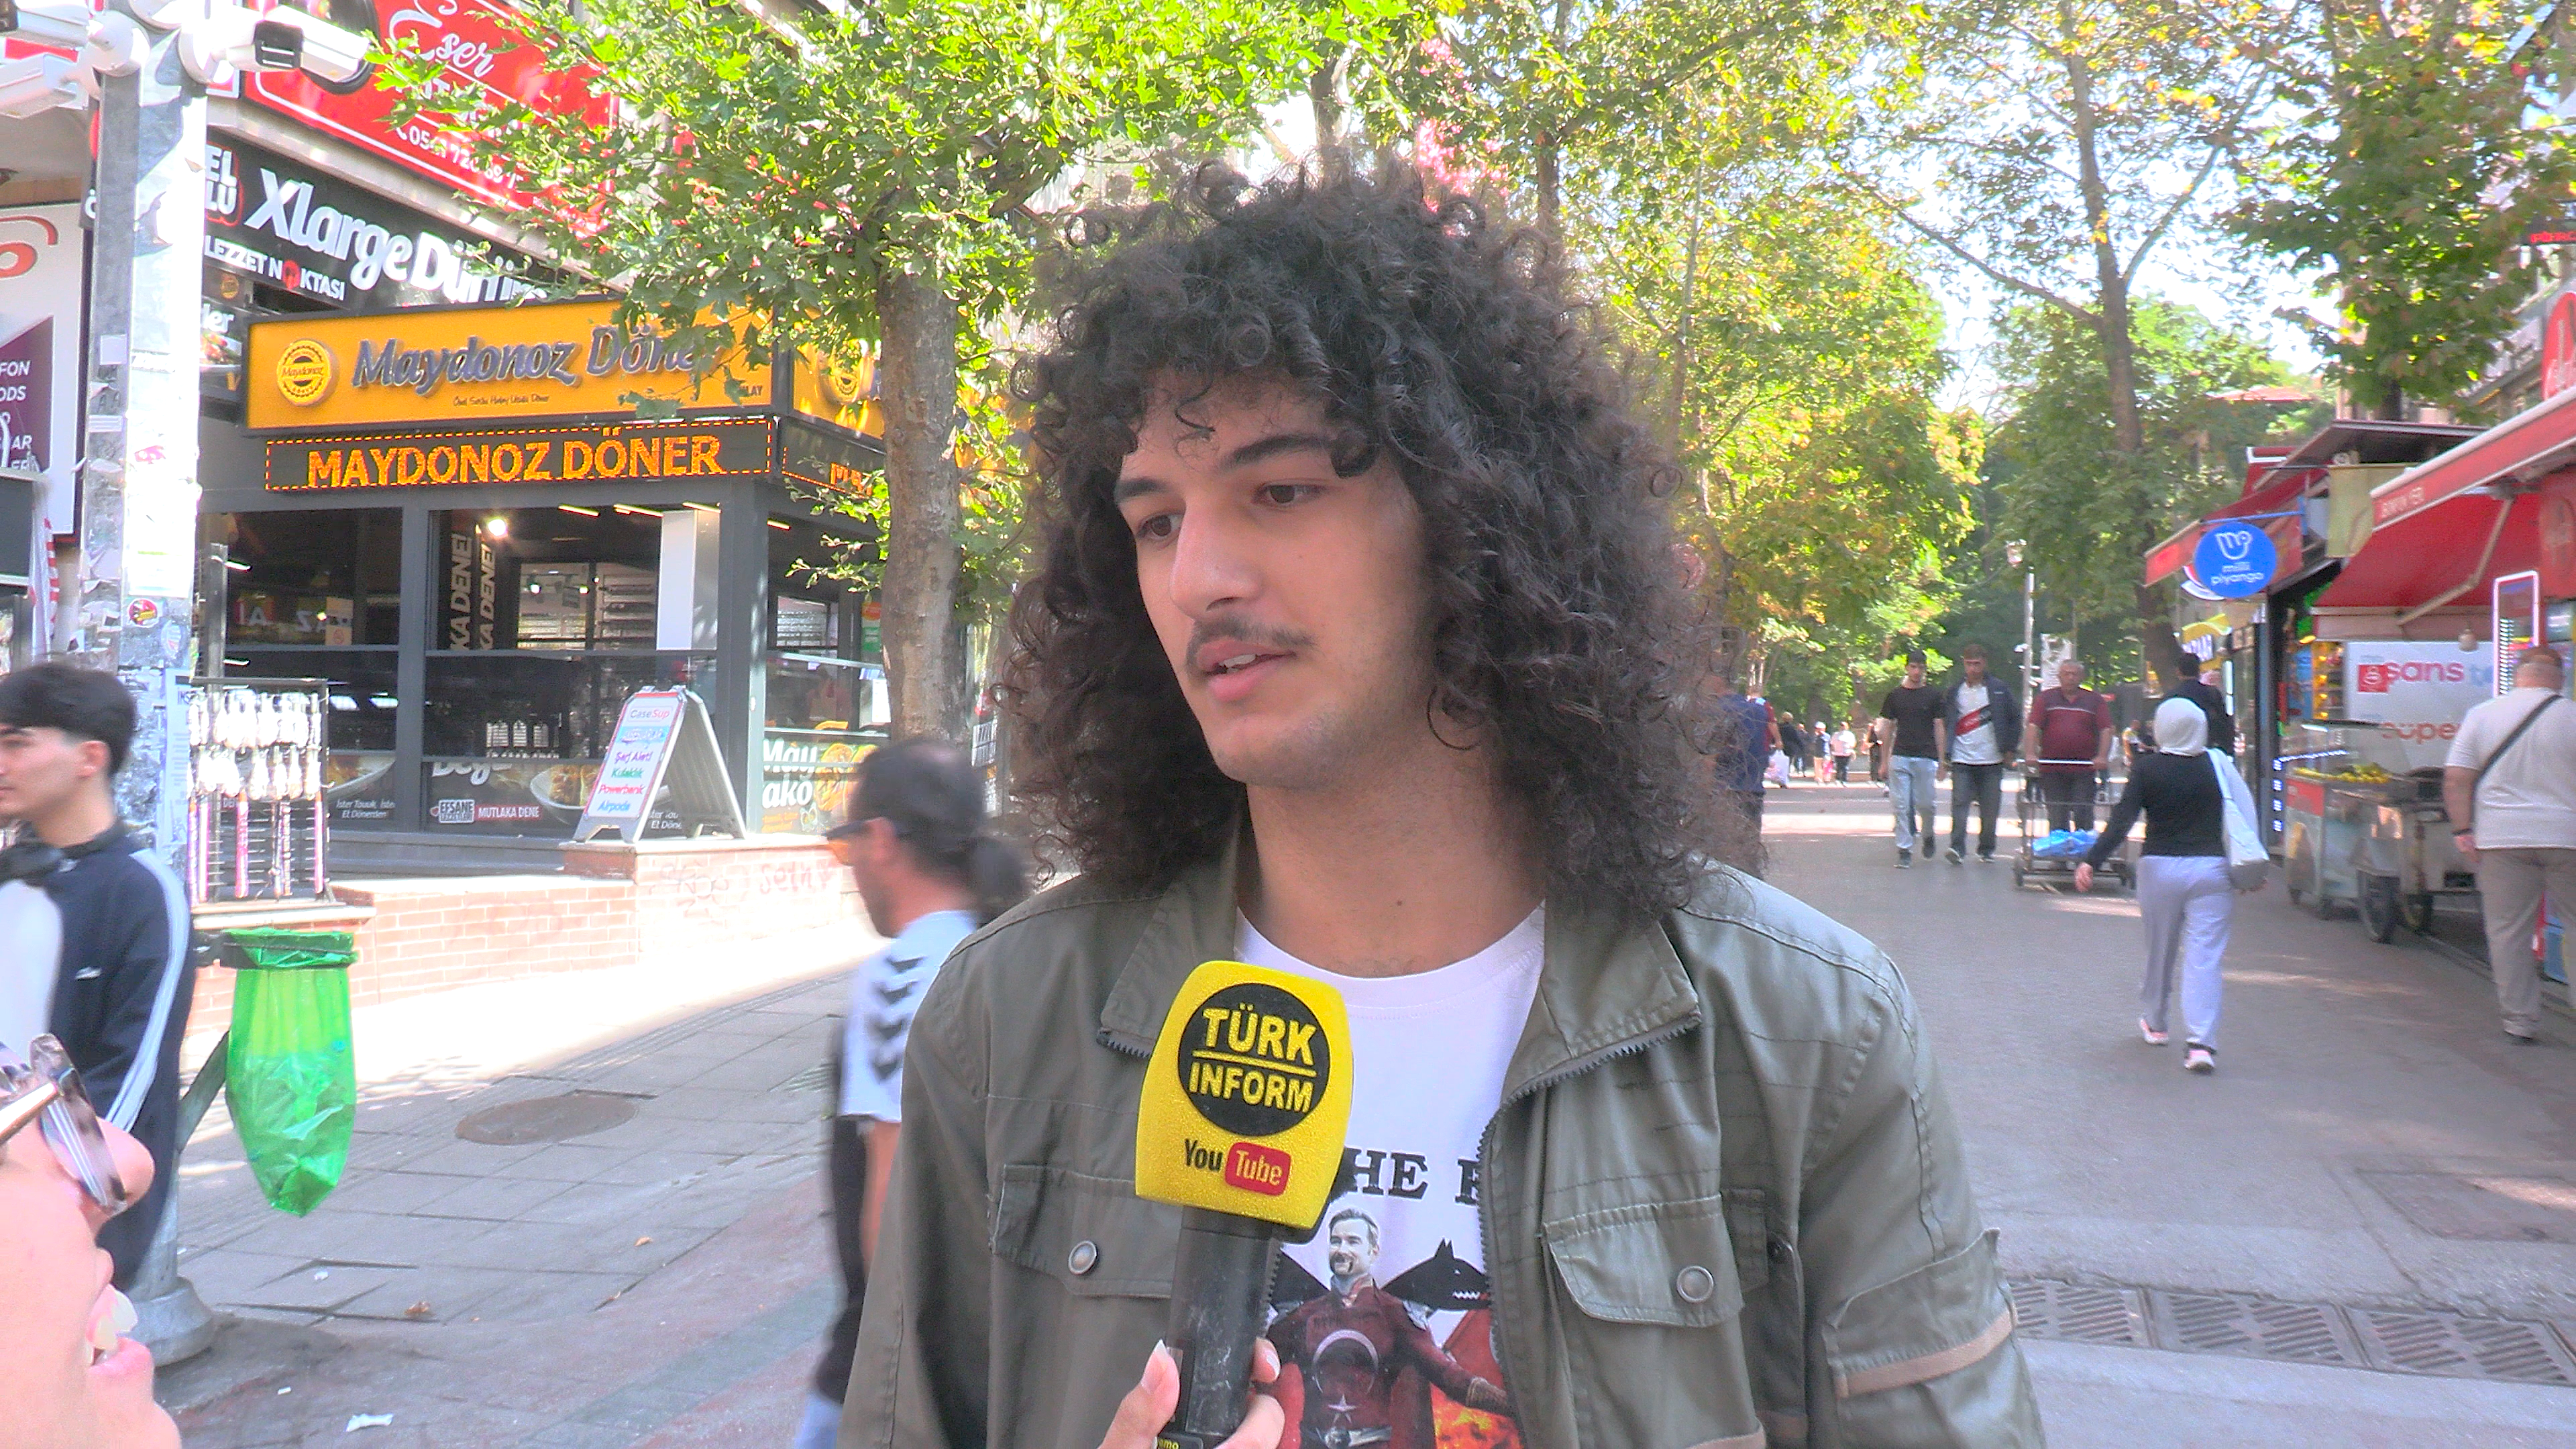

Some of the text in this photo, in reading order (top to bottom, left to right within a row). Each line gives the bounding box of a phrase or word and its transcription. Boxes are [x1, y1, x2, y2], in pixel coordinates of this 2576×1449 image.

[204, 235, 269, 275] LEZZET
[244, 167, 413, 291] Xlarge
[352, 323, 699, 396] Maydonoz Döne
[308, 427, 724, 488] MAYDONOZ DÖNER
[478, 806, 516, 818] MUTLAKA
[1201, 1003, 1317, 1065] TÜRK
[1189, 1062, 1315, 1114] INFORM
[1184, 1138, 1283, 1187] You Tube
[1344, 1147, 1428, 1201] HE
